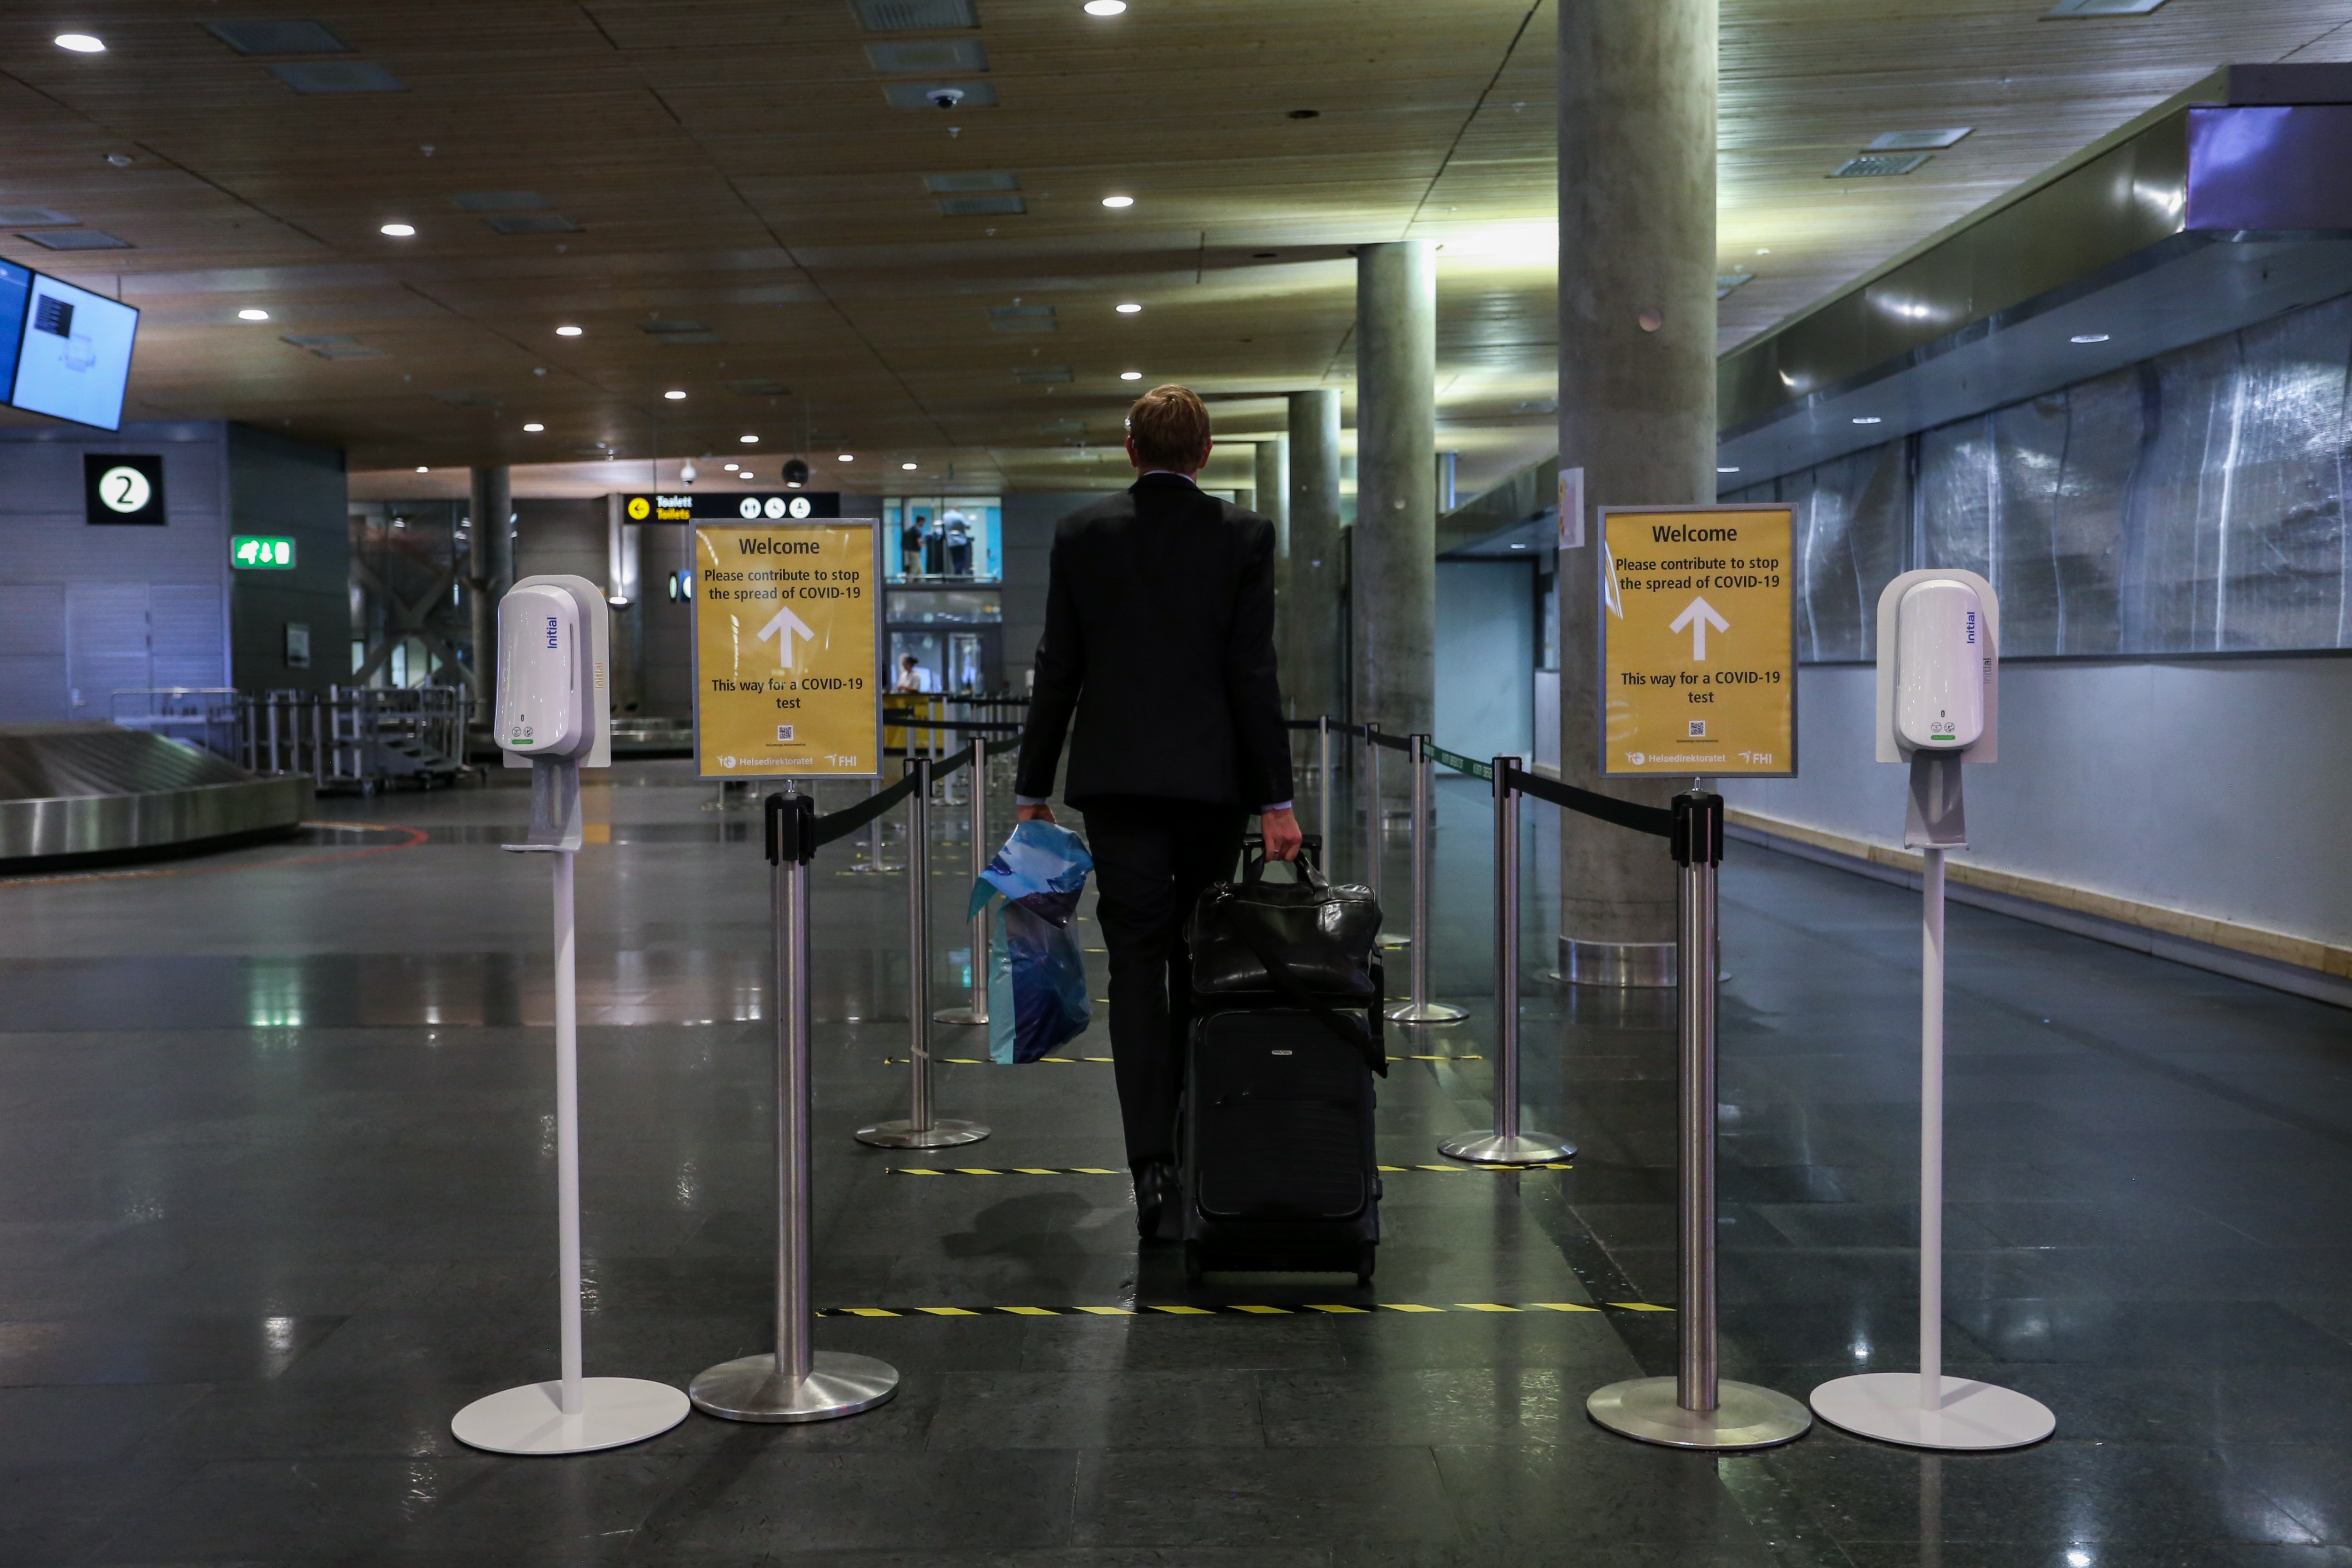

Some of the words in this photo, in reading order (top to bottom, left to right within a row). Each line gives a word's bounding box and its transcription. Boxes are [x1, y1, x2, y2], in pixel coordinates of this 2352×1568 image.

[116, 476, 134, 504] 2
[656, 495, 692, 507] Toalett
[656, 508, 690, 520] Toilets
[1653, 525, 1737, 542] Welcome
[739, 538, 819, 554] Welcome
[1616, 559, 1656, 570] Please
[1661, 557, 1725, 570] contribute
[1731, 558, 1745, 568] to
[1749, 557, 1779, 571] stop
[705, 570, 743, 581] Please
[748, 568, 810, 581] contribute
[814, 570, 827, 580] to
[832, 570, 859, 582] stop
[1620, 577, 1641, 589] the
[1646, 576, 1691, 592] spread
[1696, 575, 1709, 588] of
[1715, 575, 1779, 588] COVID-19
[709, 588, 730, 599] the
[734, 587, 777, 602] spread
[782, 587, 795, 599] of
[800, 587, 860, 598] COVID-19
[547, 617, 557, 648] Initial
[1966, 612, 1975, 644] Initial
[712, 680, 735, 691] This
[740, 681, 764, 693] way
[768, 679, 786, 690] for
[790, 681, 797, 690] a
[802, 678, 862, 690] COVID-19
[1621, 672, 1645, 685] This
[1651, 674, 1677, 687] way
[1680, 671, 1699, 684] for
[1703, 674, 1710, 684] a
[1716, 671, 1780, 684] COVID-19
[777, 697, 801, 708] test
[1688, 691, 1714, 703] test
[740, 757, 812, 766] Helsedirektoratet
[839, 756, 857, 766] FHI
[1649, 752, 1725, 763] Helsedirektoratet
[1753, 753, 1772, 764] FHI
